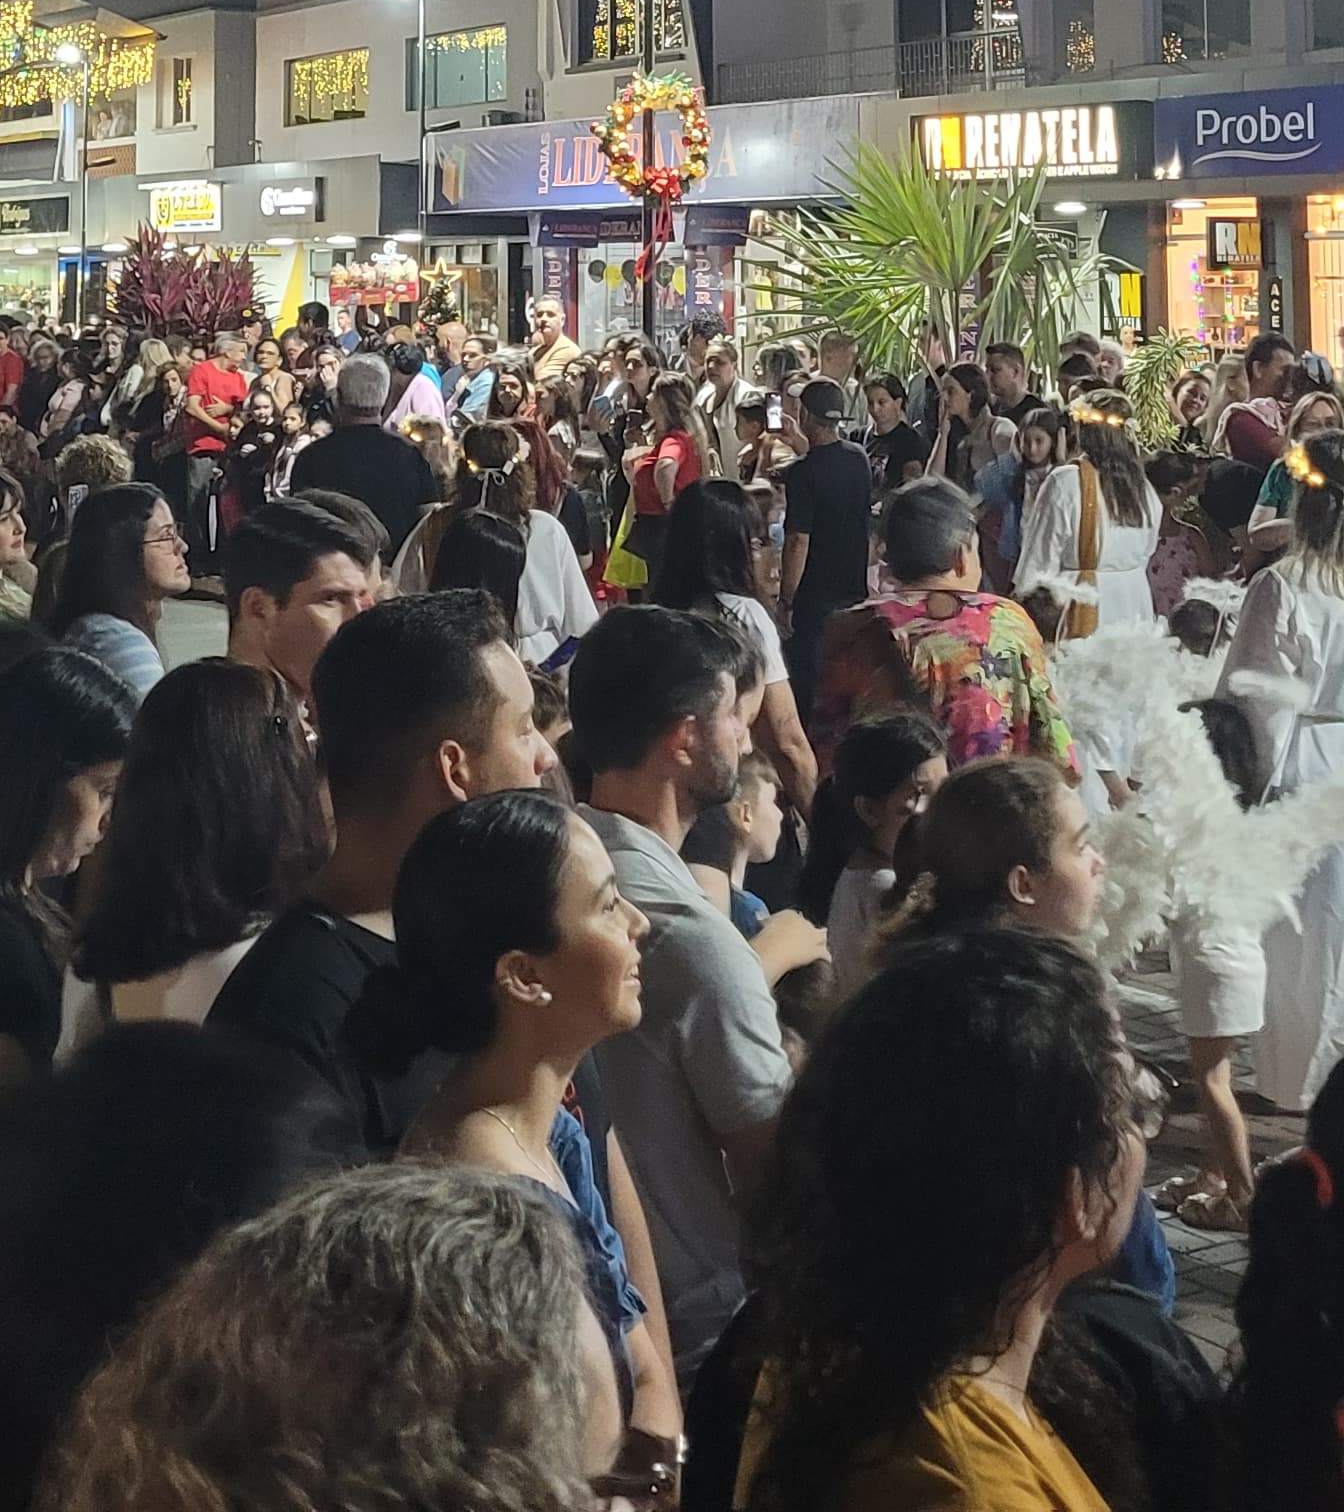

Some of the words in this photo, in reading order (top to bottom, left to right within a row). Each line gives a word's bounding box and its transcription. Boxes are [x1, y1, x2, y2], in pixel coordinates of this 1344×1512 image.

[1196, 102, 1316, 145] Probel
[537, 131, 551, 194] LOJAS
[1215, 222, 1261, 255] RN
[1270, 283, 1281, 328] ACE
